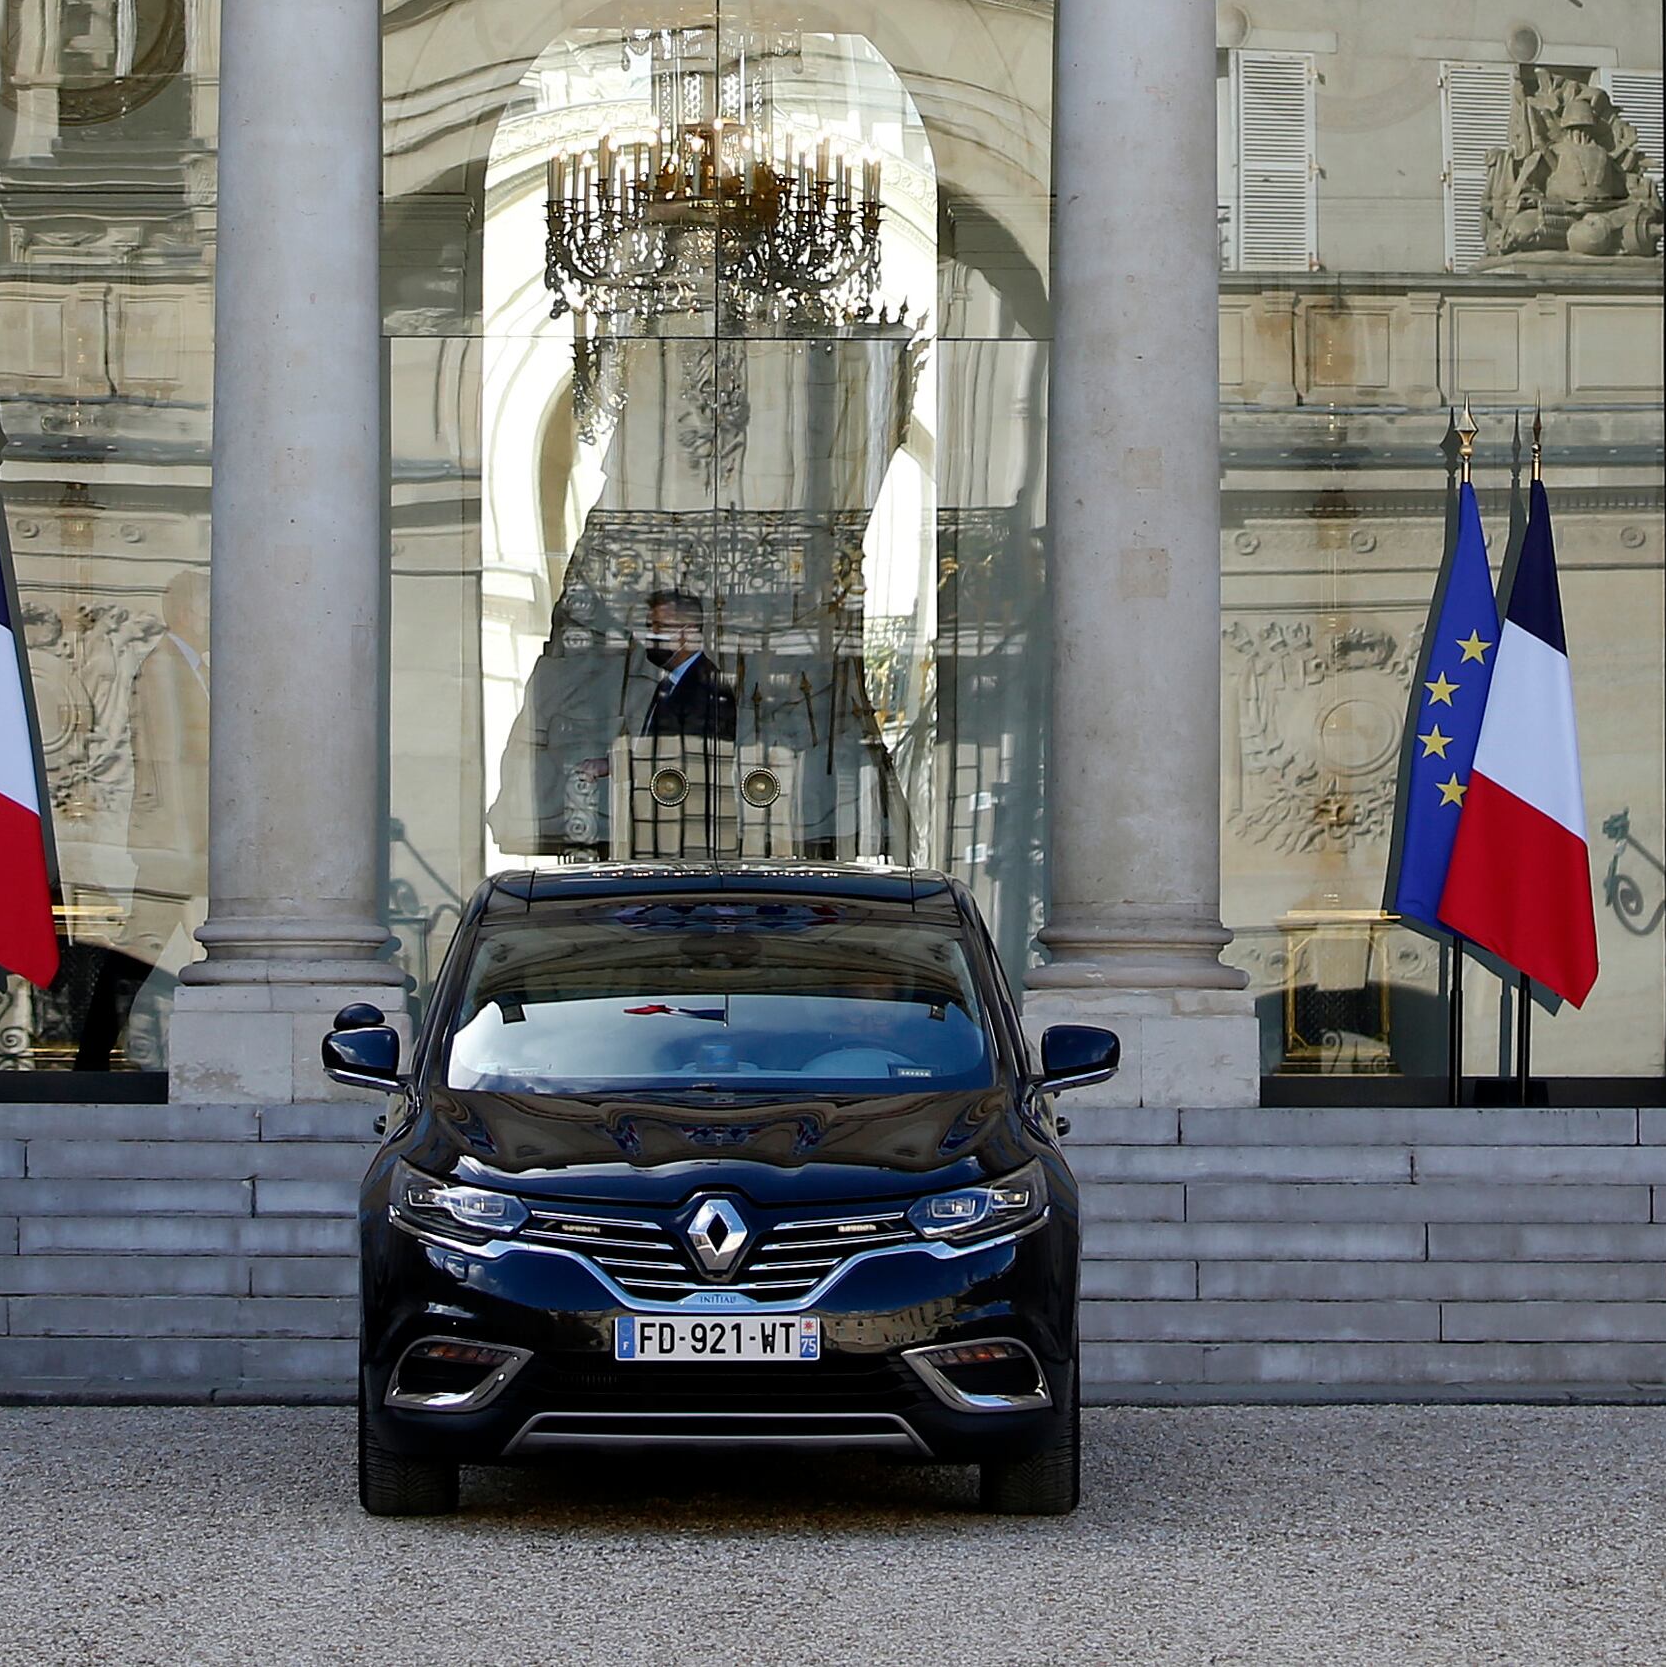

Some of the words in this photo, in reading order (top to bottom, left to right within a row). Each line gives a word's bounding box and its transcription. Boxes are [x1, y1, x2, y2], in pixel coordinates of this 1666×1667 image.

[623, 1341, 630, 1351] F
[639, 1322, 796, 1354] FD-921-WT
[801, 1337, 817, 1353] 75
